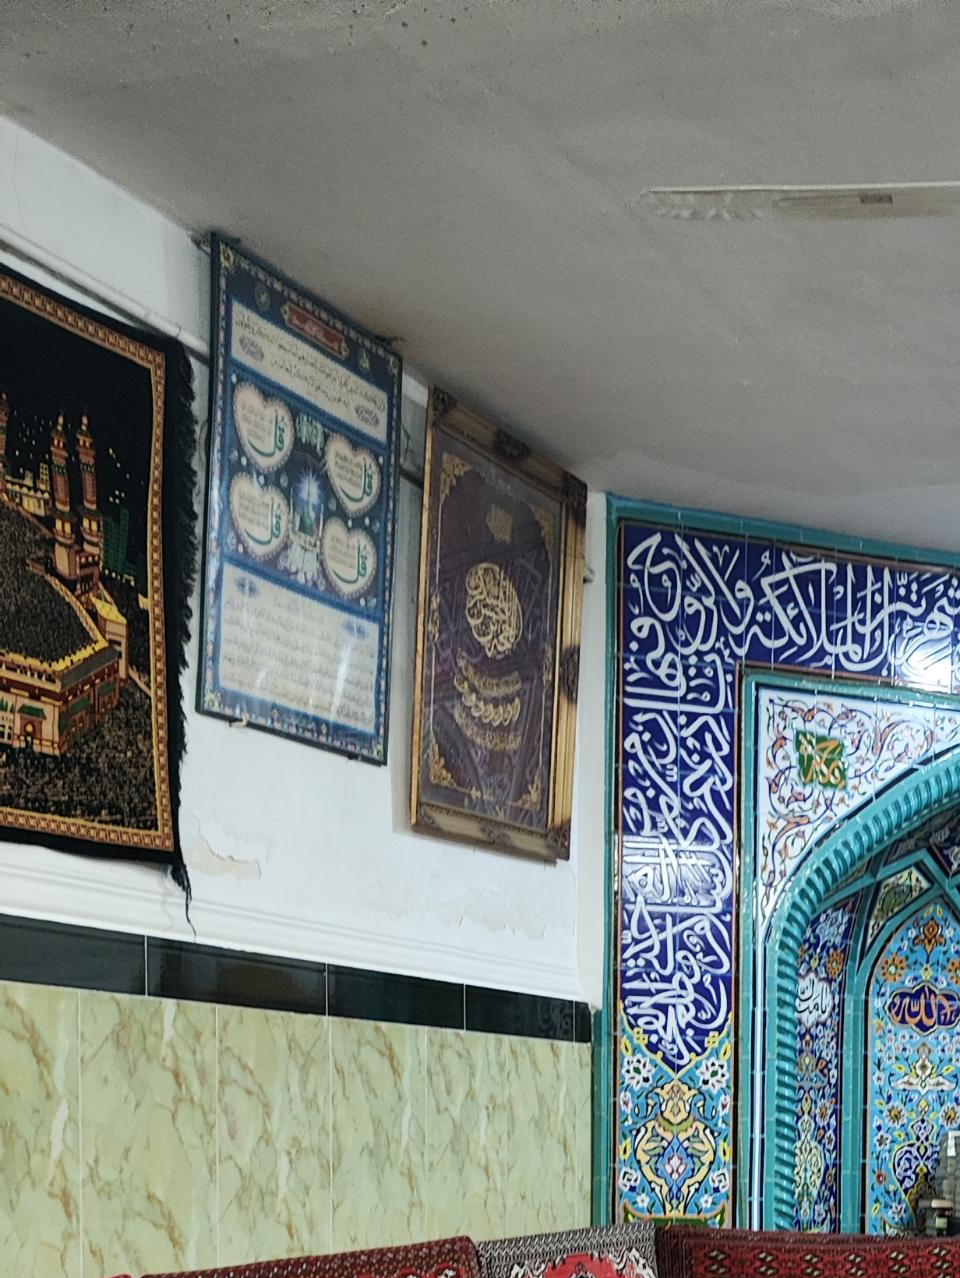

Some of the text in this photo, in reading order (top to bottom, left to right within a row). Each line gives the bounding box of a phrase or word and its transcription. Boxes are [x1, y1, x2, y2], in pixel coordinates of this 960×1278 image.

[247, 409, 285, 457] قل
[339, 456, 374, 502] قل
[244, 497, 282, 545] قل
[332, 539, 368, 584] قل
